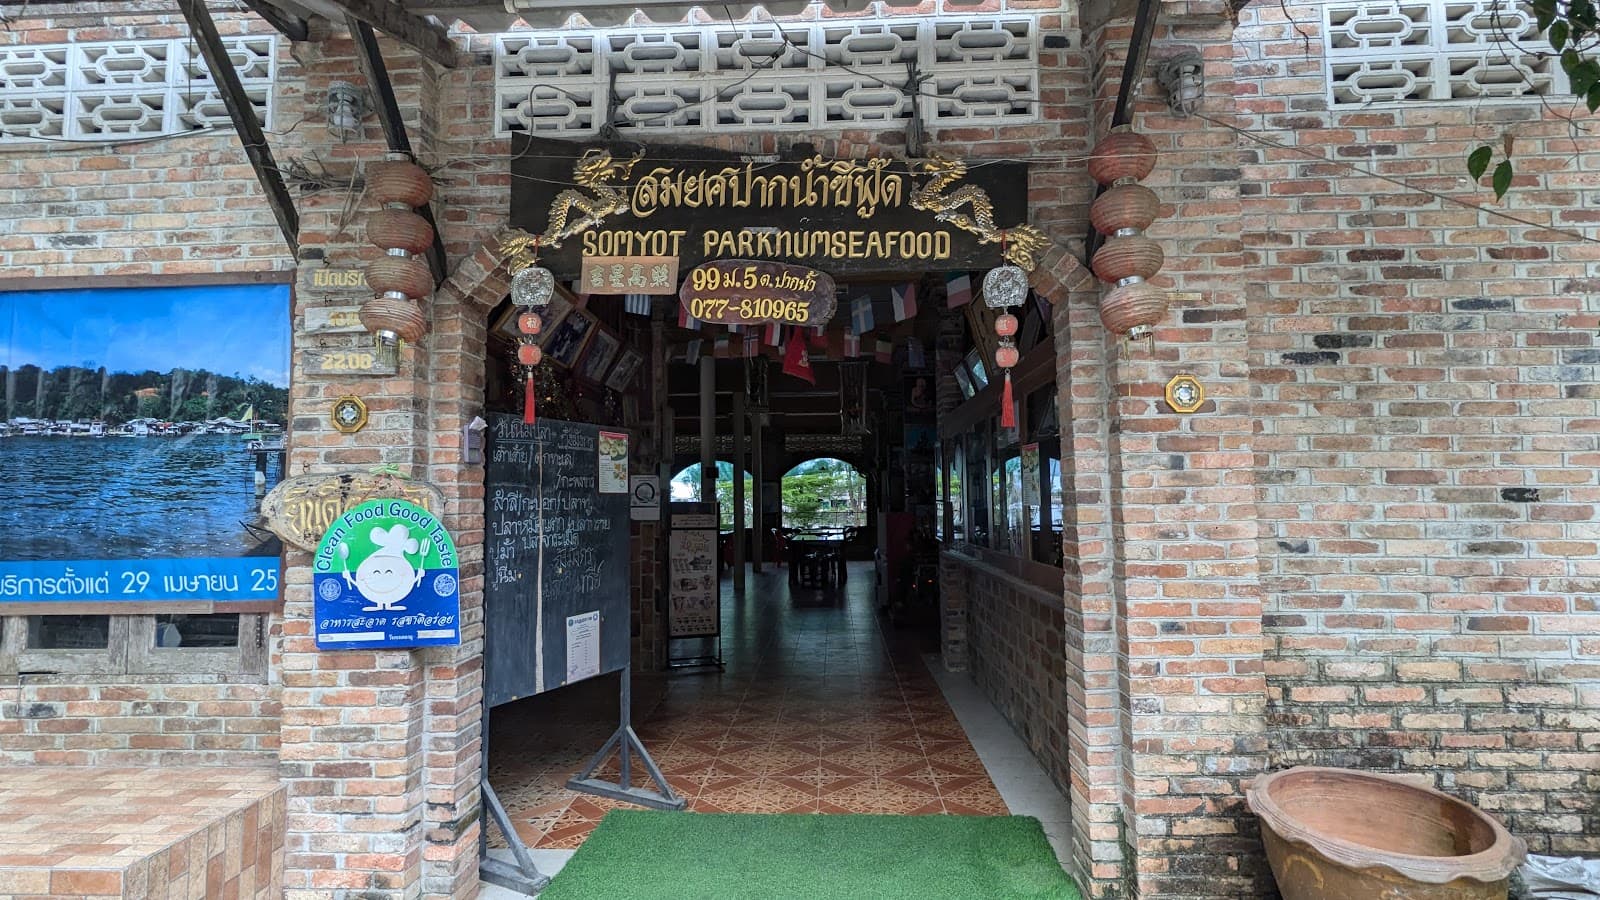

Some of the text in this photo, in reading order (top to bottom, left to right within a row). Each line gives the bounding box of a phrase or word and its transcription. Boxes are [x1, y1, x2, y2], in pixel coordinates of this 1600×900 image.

[582, 230, 687, 257] SOMYOT
[692, 267, 721, 291] 99
[690, 298, 810, 323] 077-810965
[316, 502, 452, 571] Clean Food Good Taste
[120, 571, 150, 593] 29
[163, 574, 239, 592] เมษายน
[251, 568, 278, 592] 25
